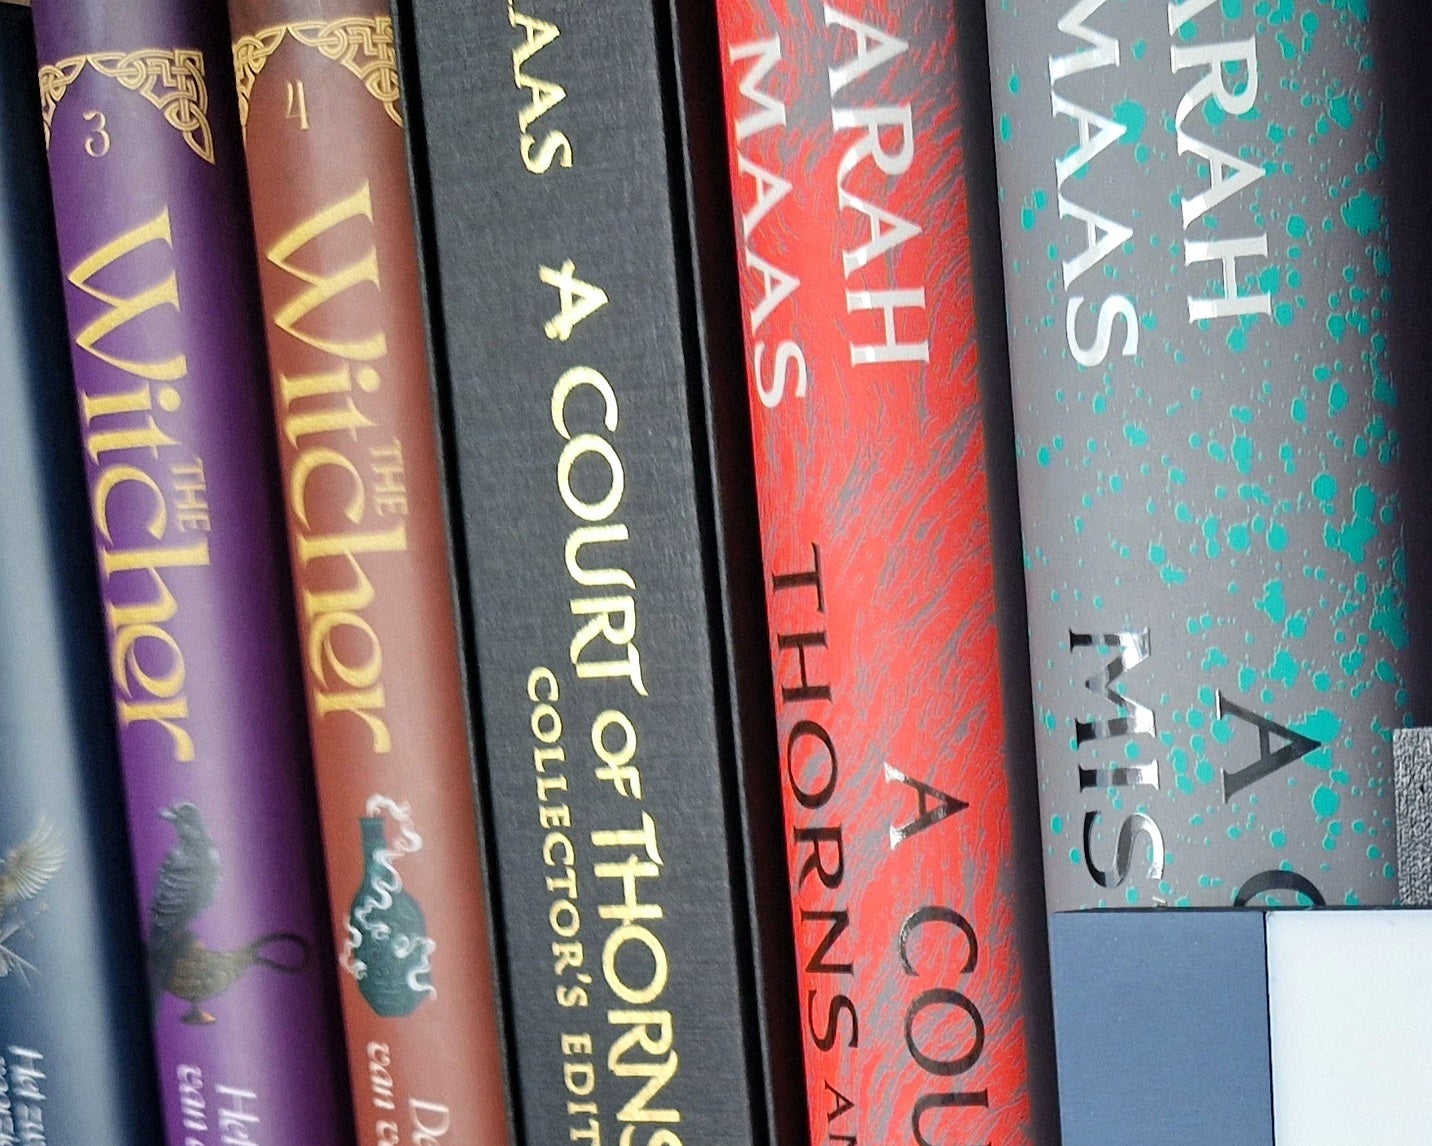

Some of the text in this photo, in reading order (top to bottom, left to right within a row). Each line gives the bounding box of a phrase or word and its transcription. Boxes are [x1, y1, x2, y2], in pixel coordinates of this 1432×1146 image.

[82, 109, 111, 158] 3
[284, 79, 311, 131] 4
[728, 33, 809, 410] MAAS
[539, 259, 609, 342] A
[67, 205, 210, 762] Witcher
[173, 459, 213, 533] THE
[267, 180, 408, 754] Witcher
[371, 439, 409, 517] THE
[550, 365, 649, 697] COURT
[590, 710, 642, 799] OF
[1069, 626, 1167, 907] MIS
[1215, 689, 1321, 803] A
[527, 667, 590, 1010] COLLECTOR'S
[771, 542, 860, 1055] THORNS
[883, 761, 970, 850] A
[176, 1064, 209, 1132] van
[367, 1041, 397, 1110] van
